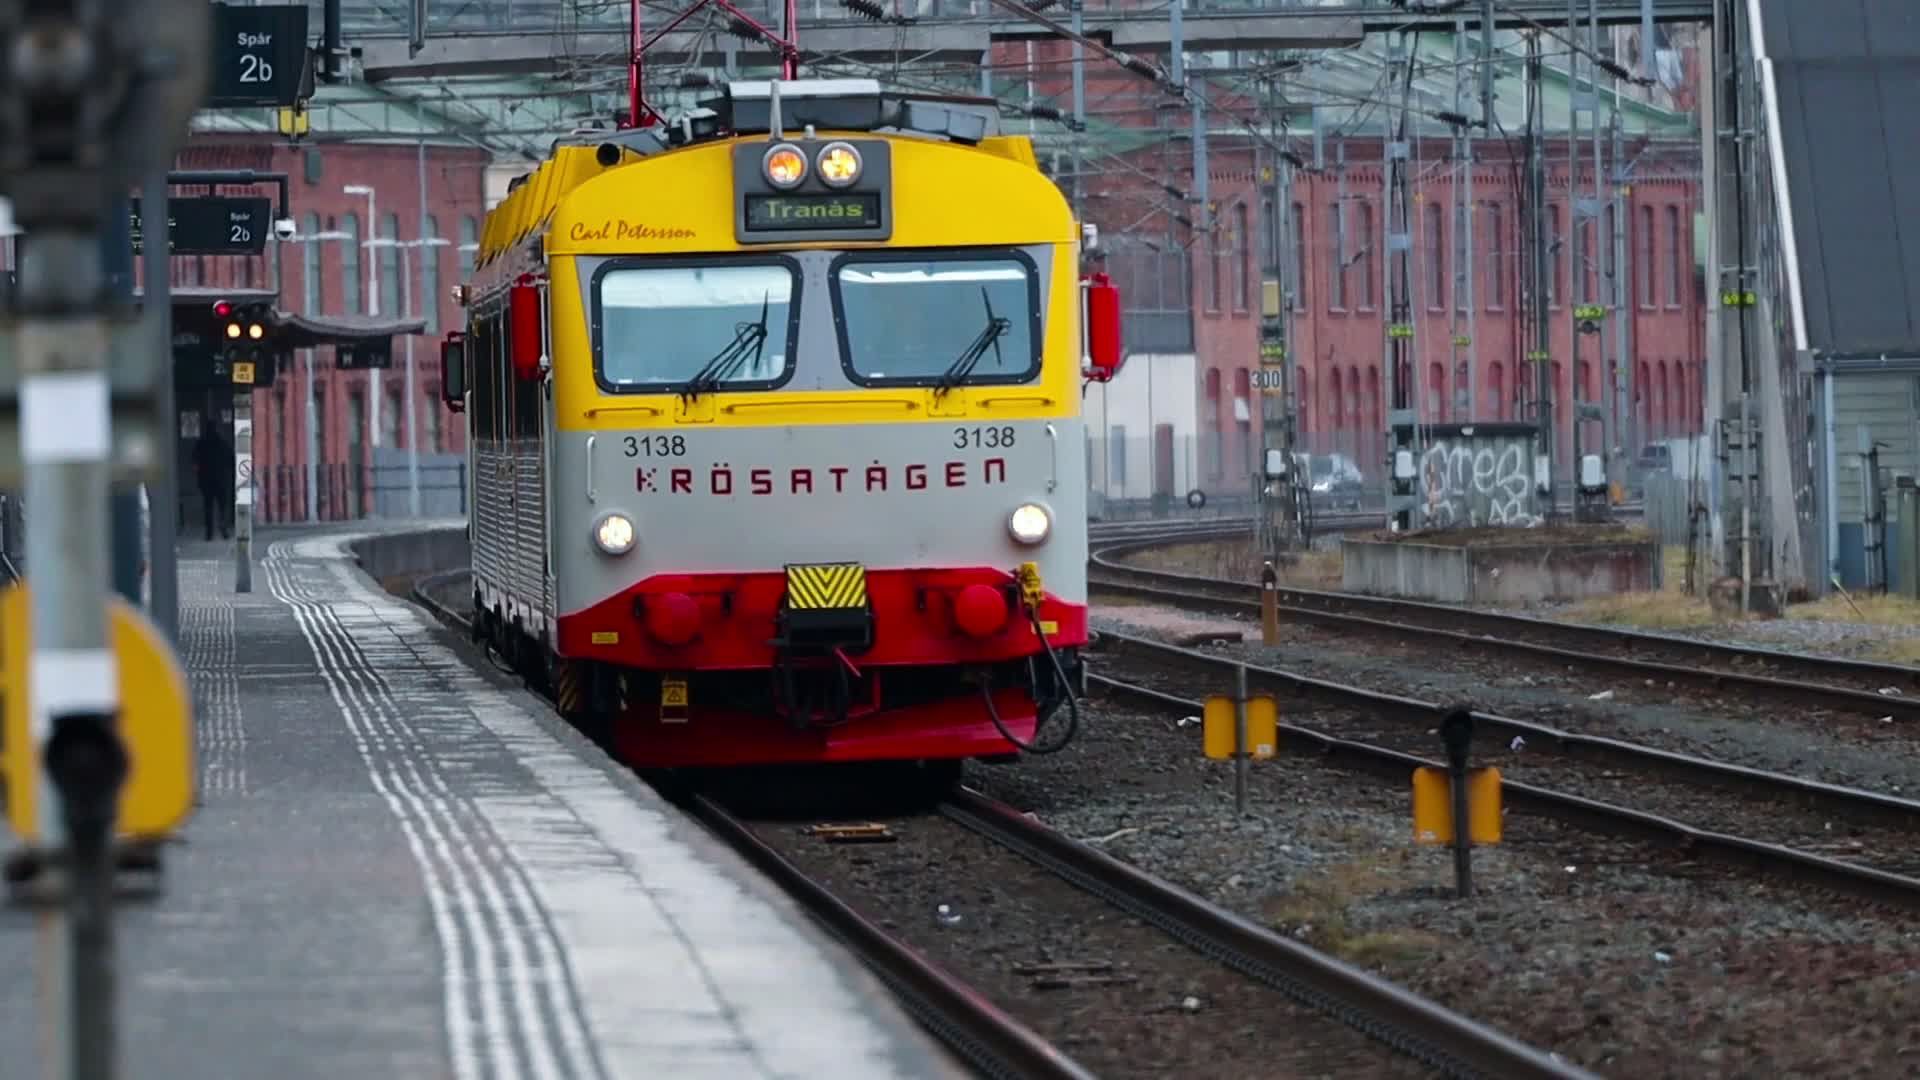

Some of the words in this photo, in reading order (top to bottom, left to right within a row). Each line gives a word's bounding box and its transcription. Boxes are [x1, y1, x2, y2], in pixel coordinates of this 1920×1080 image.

[237, 32, 272, 48] Spår
[239, 54, 273, 82] 2b
[764, 199, 864, 218] Tranås
[230, 225, 251, 243] 2b
[569, 220, 609, 241] Carl
[616, 219, 698, 241] Petersson
[1250, 369, 1281, 389] 300
[623, 435, 687, 458] 3138
[953, 426, 1016, 449] 3138
